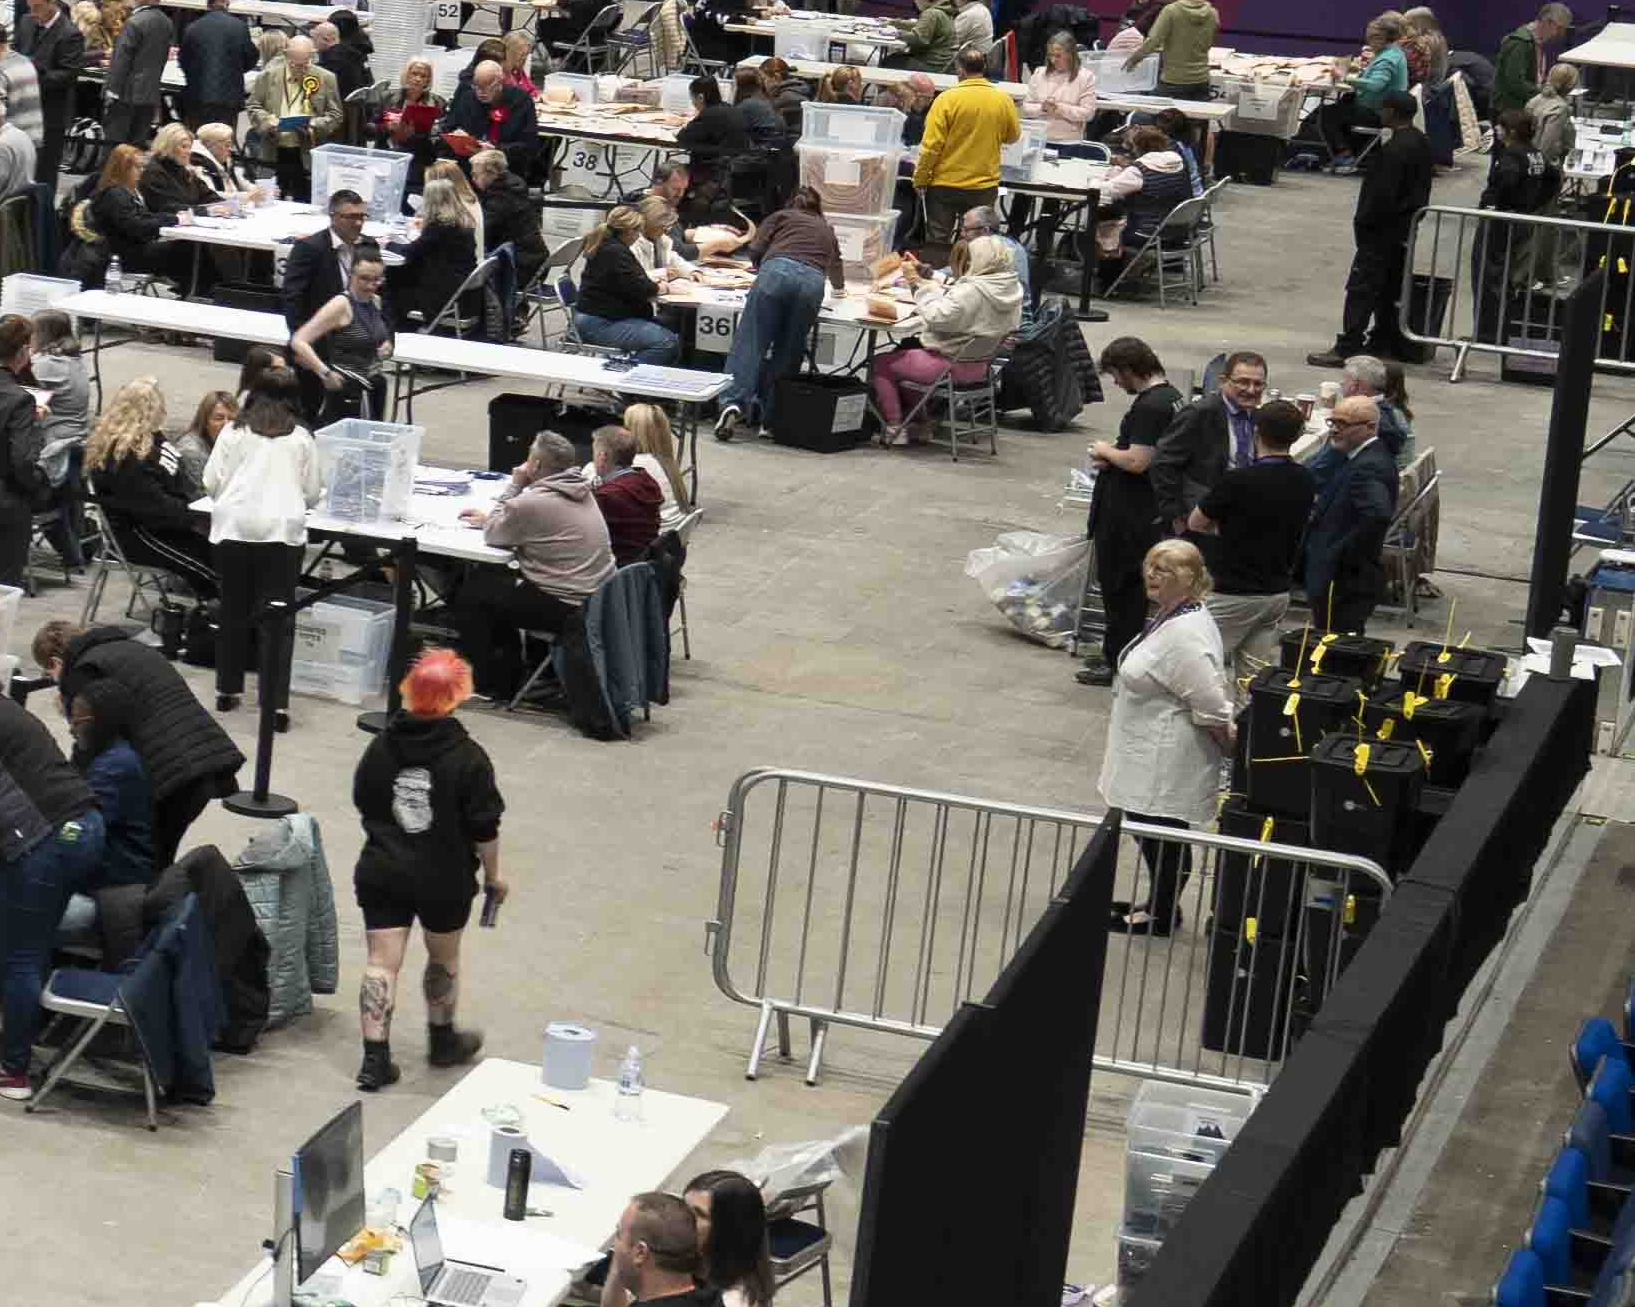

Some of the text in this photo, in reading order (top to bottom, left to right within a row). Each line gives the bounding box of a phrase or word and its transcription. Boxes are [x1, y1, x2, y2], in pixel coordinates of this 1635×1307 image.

[438, 3, 459, 18] 52
[573, 151, 598, 171] 38
[698, 315, 730, 337] 36
